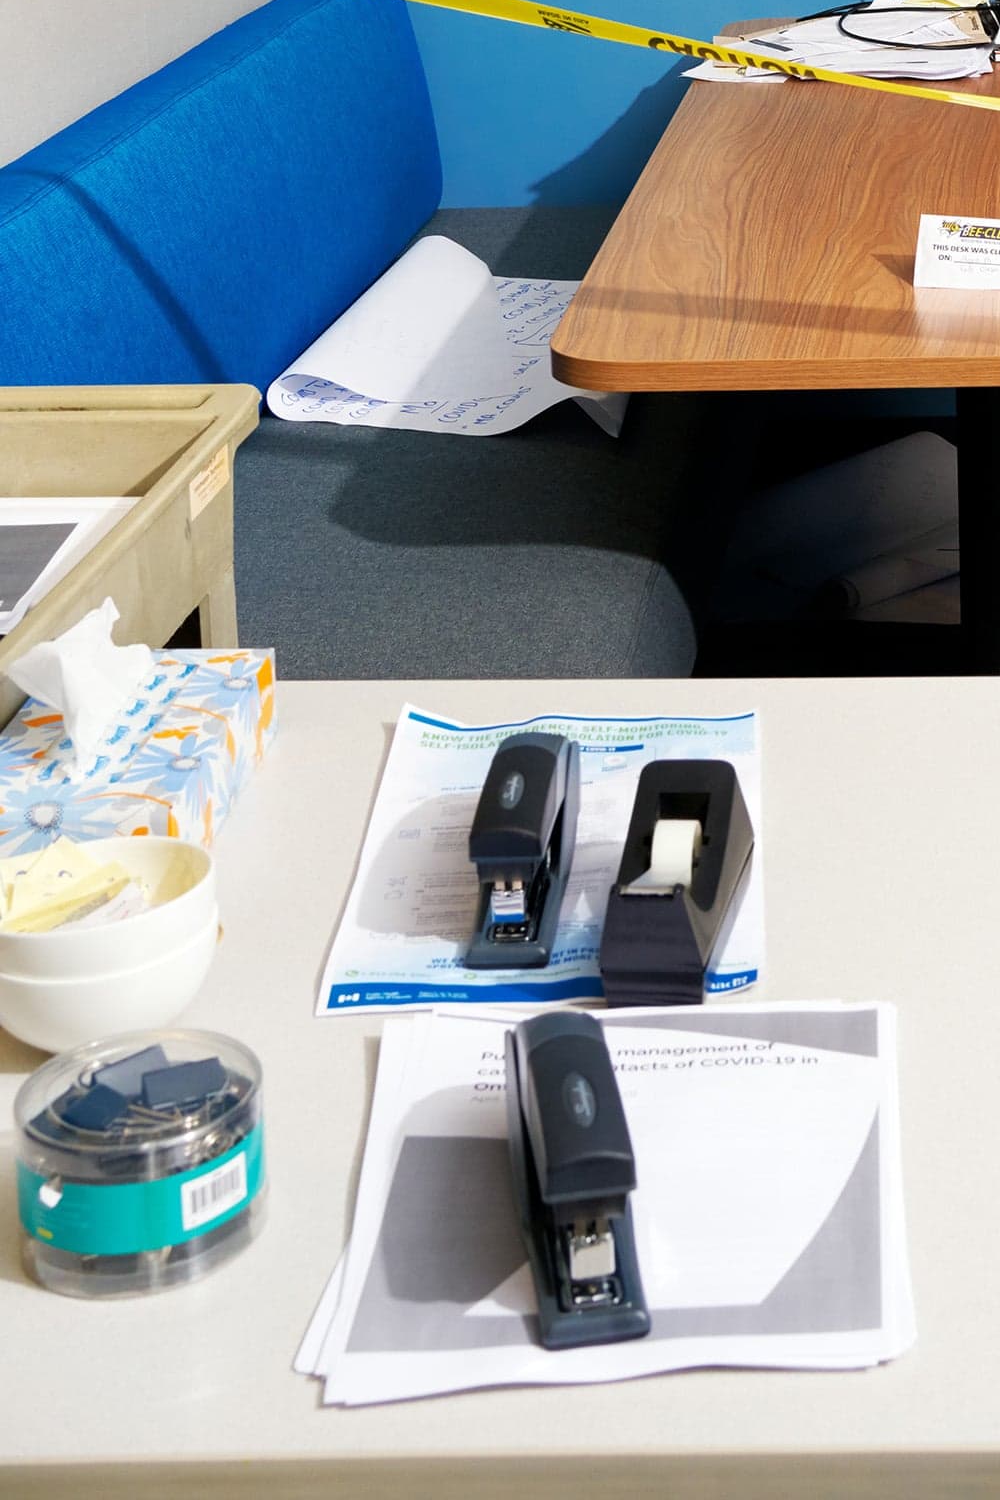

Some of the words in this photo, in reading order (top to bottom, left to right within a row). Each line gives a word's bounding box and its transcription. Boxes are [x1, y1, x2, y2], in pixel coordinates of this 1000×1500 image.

[932, 244, 949, 252] THIS
[950, 245, 969, 253] DESK
[971, 246, 988, 255] WAS
[419, 740, 500, 750] SELF-ISOLA
[637, 730, 664, 741] FOR
[468, 733, 491, 742] THE
[617, 1043, 749, 1057] management
[755, 1040, 774, 1051] of
[612, 1061, 669, 1073] tacts
[675, 1059, 694, 1070] of
[700, 1055, 797, 1069] COVID-19
[802, 1055, 819, 1066] in
